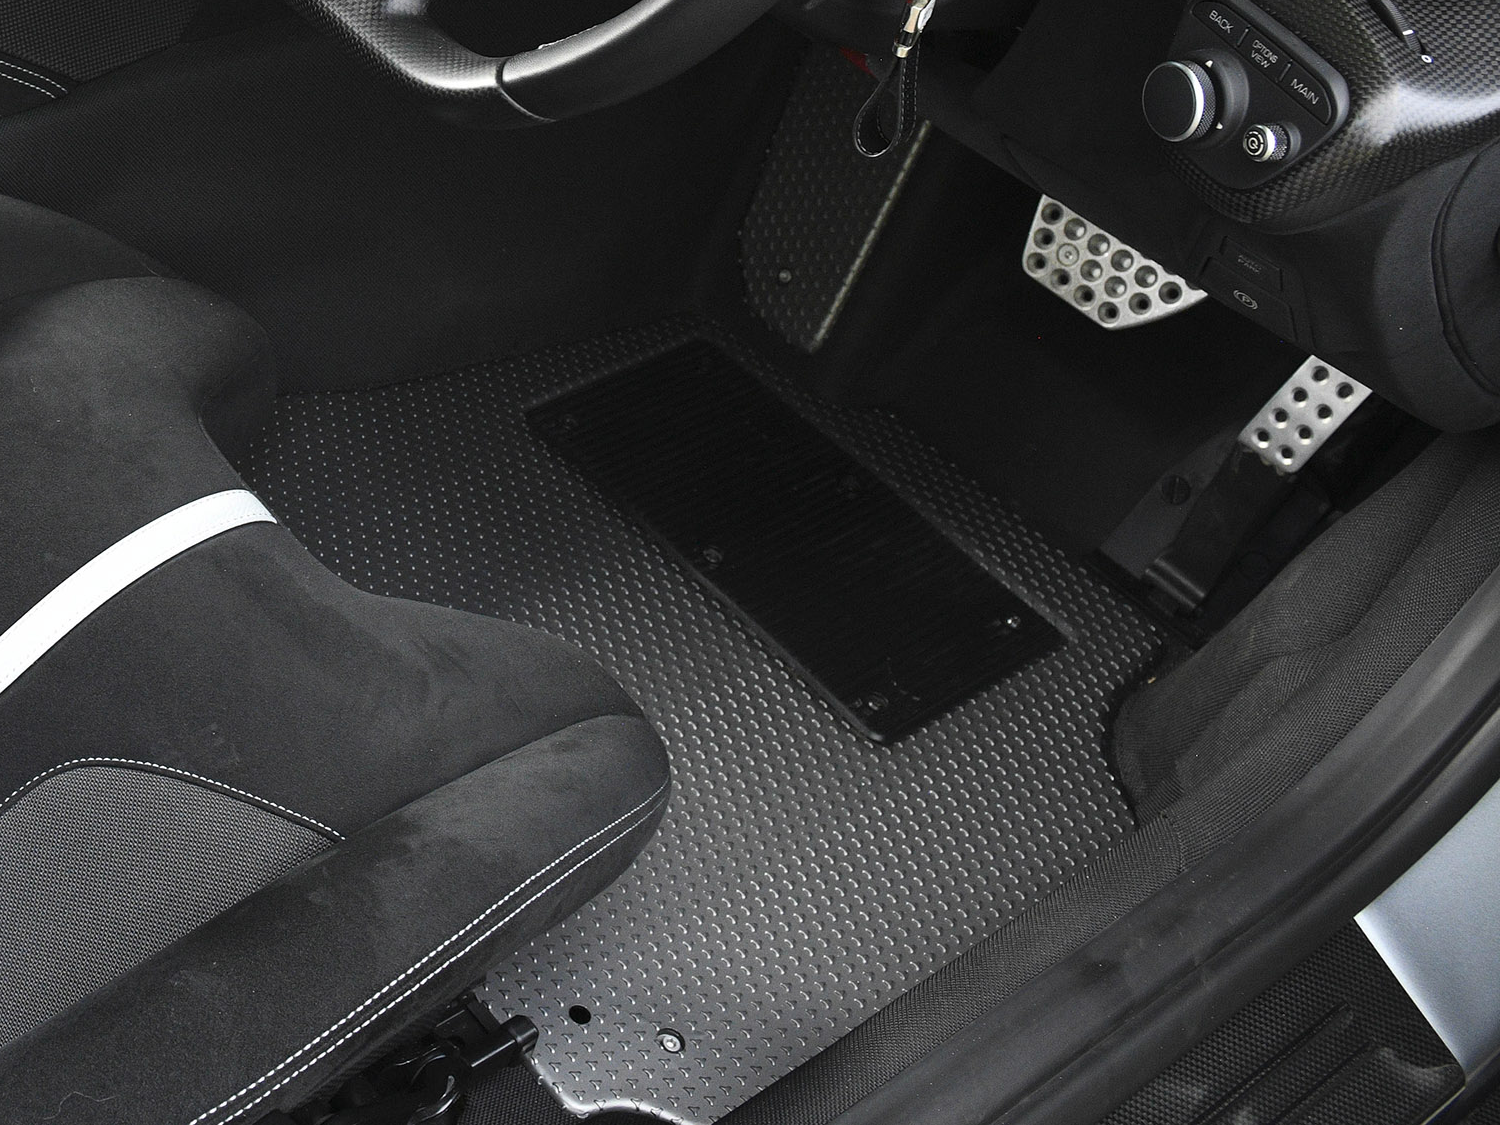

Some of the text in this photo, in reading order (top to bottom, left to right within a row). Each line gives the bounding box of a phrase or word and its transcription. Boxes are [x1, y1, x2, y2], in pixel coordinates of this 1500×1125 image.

[1209, 10, 1233, 34] BACK
[1250, 51, 1271, 69] VIEW
[1252, 39, 1278, 64] OPTIONS
[1290, 78, 1319, 105] MAIN
